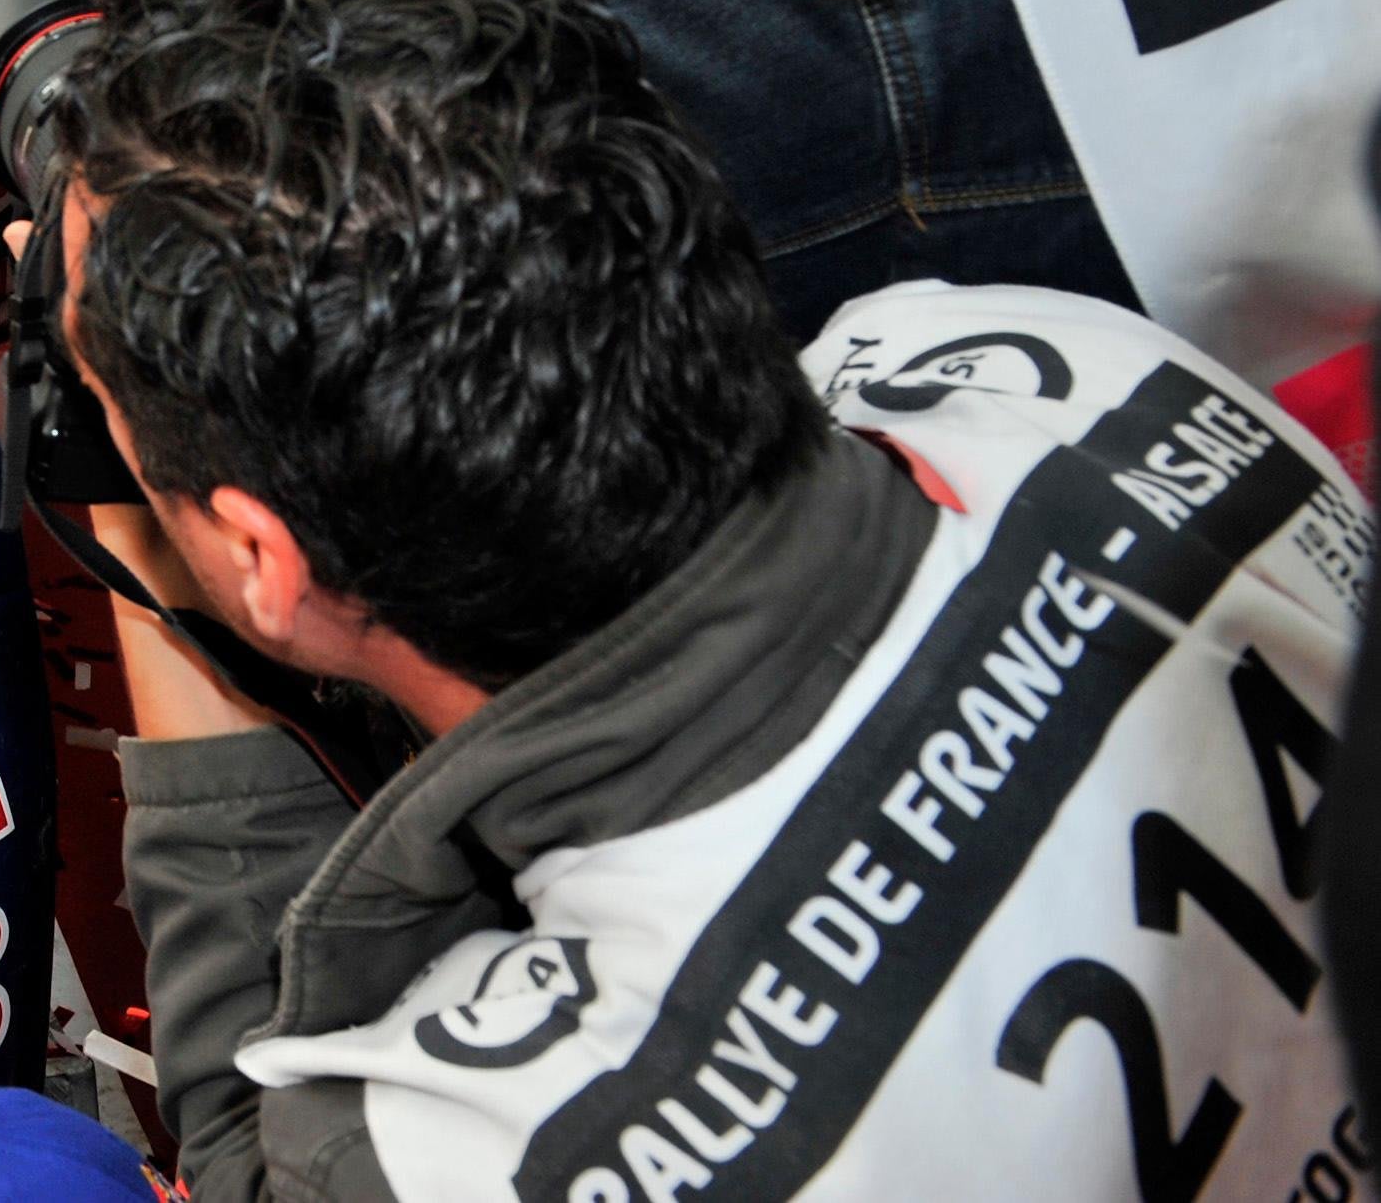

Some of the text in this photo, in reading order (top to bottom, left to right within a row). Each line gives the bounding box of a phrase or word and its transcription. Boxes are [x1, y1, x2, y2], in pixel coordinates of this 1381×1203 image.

[786, 840, 925, 987] DE
[880, 551, 1117, 865] FRANCE
[1109, 394, 1276, 533] ALSACE
